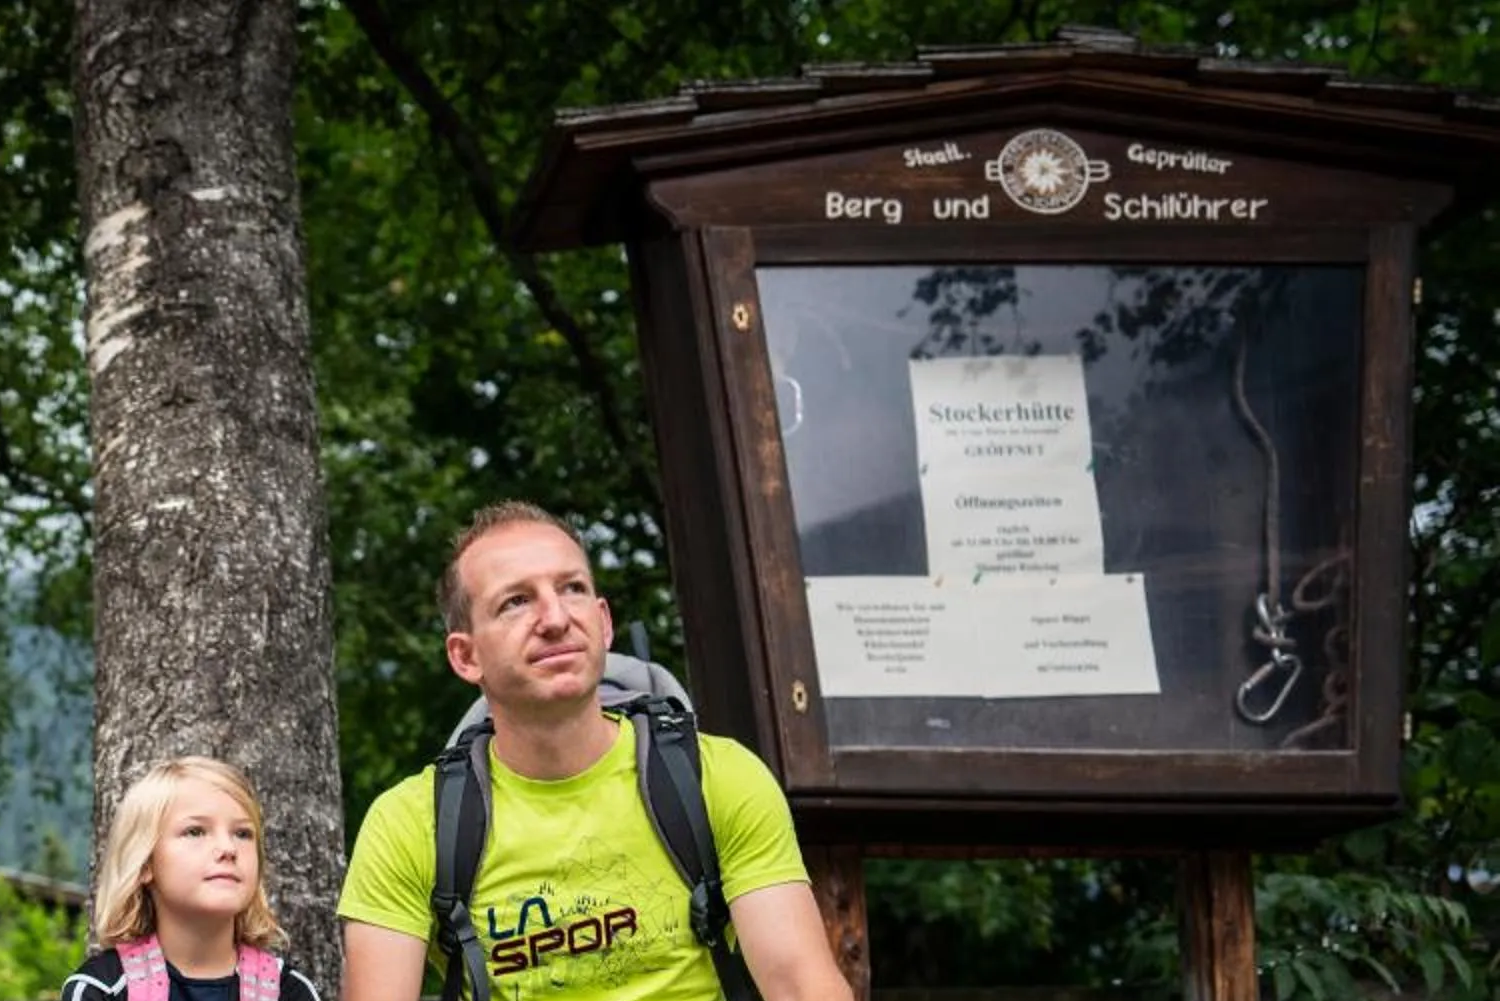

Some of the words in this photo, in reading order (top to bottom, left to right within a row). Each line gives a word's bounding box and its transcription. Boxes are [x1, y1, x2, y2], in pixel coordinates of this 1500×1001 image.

[825, 191, 903, 224] Berg
[933, 195, 990, 220] und
[929, 402, 1075, 423] Stockerhütte
[487, 897, 553, 940] LA
